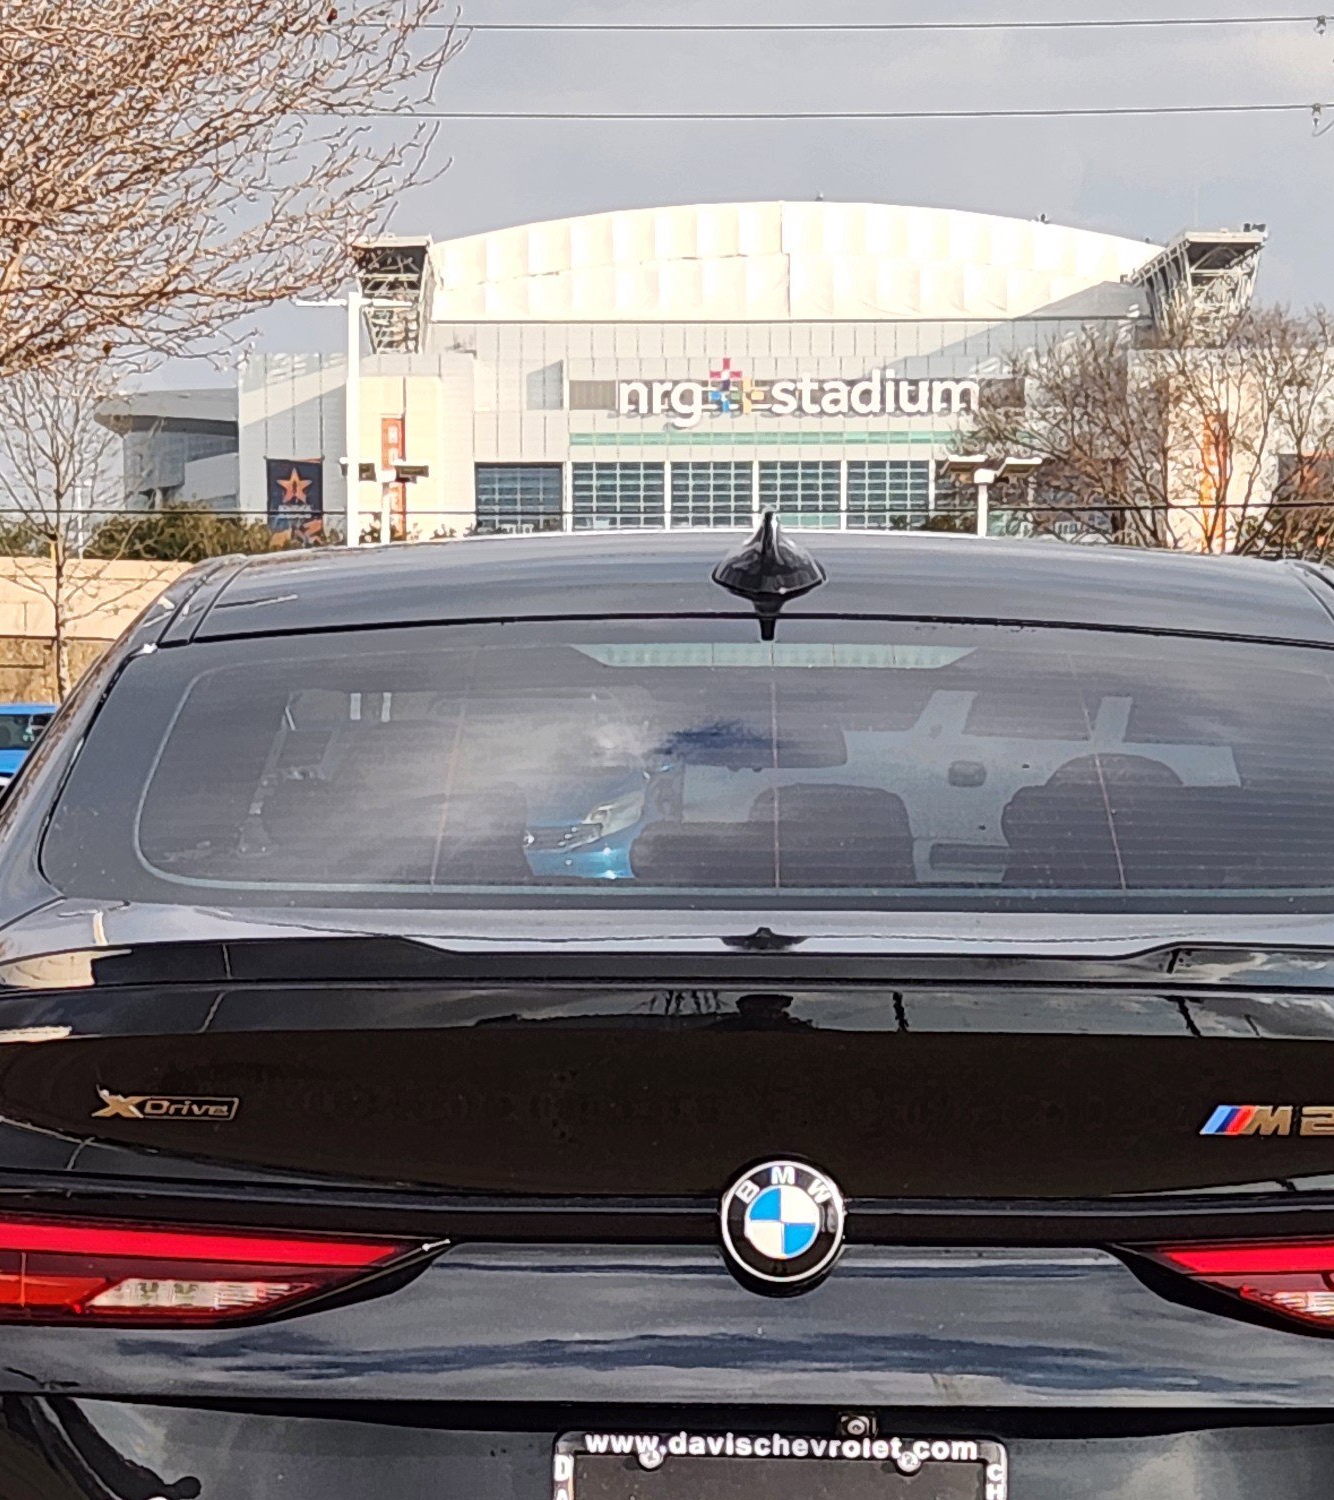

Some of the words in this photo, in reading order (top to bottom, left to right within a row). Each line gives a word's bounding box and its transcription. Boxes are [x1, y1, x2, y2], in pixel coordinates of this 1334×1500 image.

[619, 379, 703, 428] nrg
[770, 368, 979, 415] stadium
[734, 1165, 833, 1204] BMW
[585, 1431, 978, 1460] www.davischevroletcom
